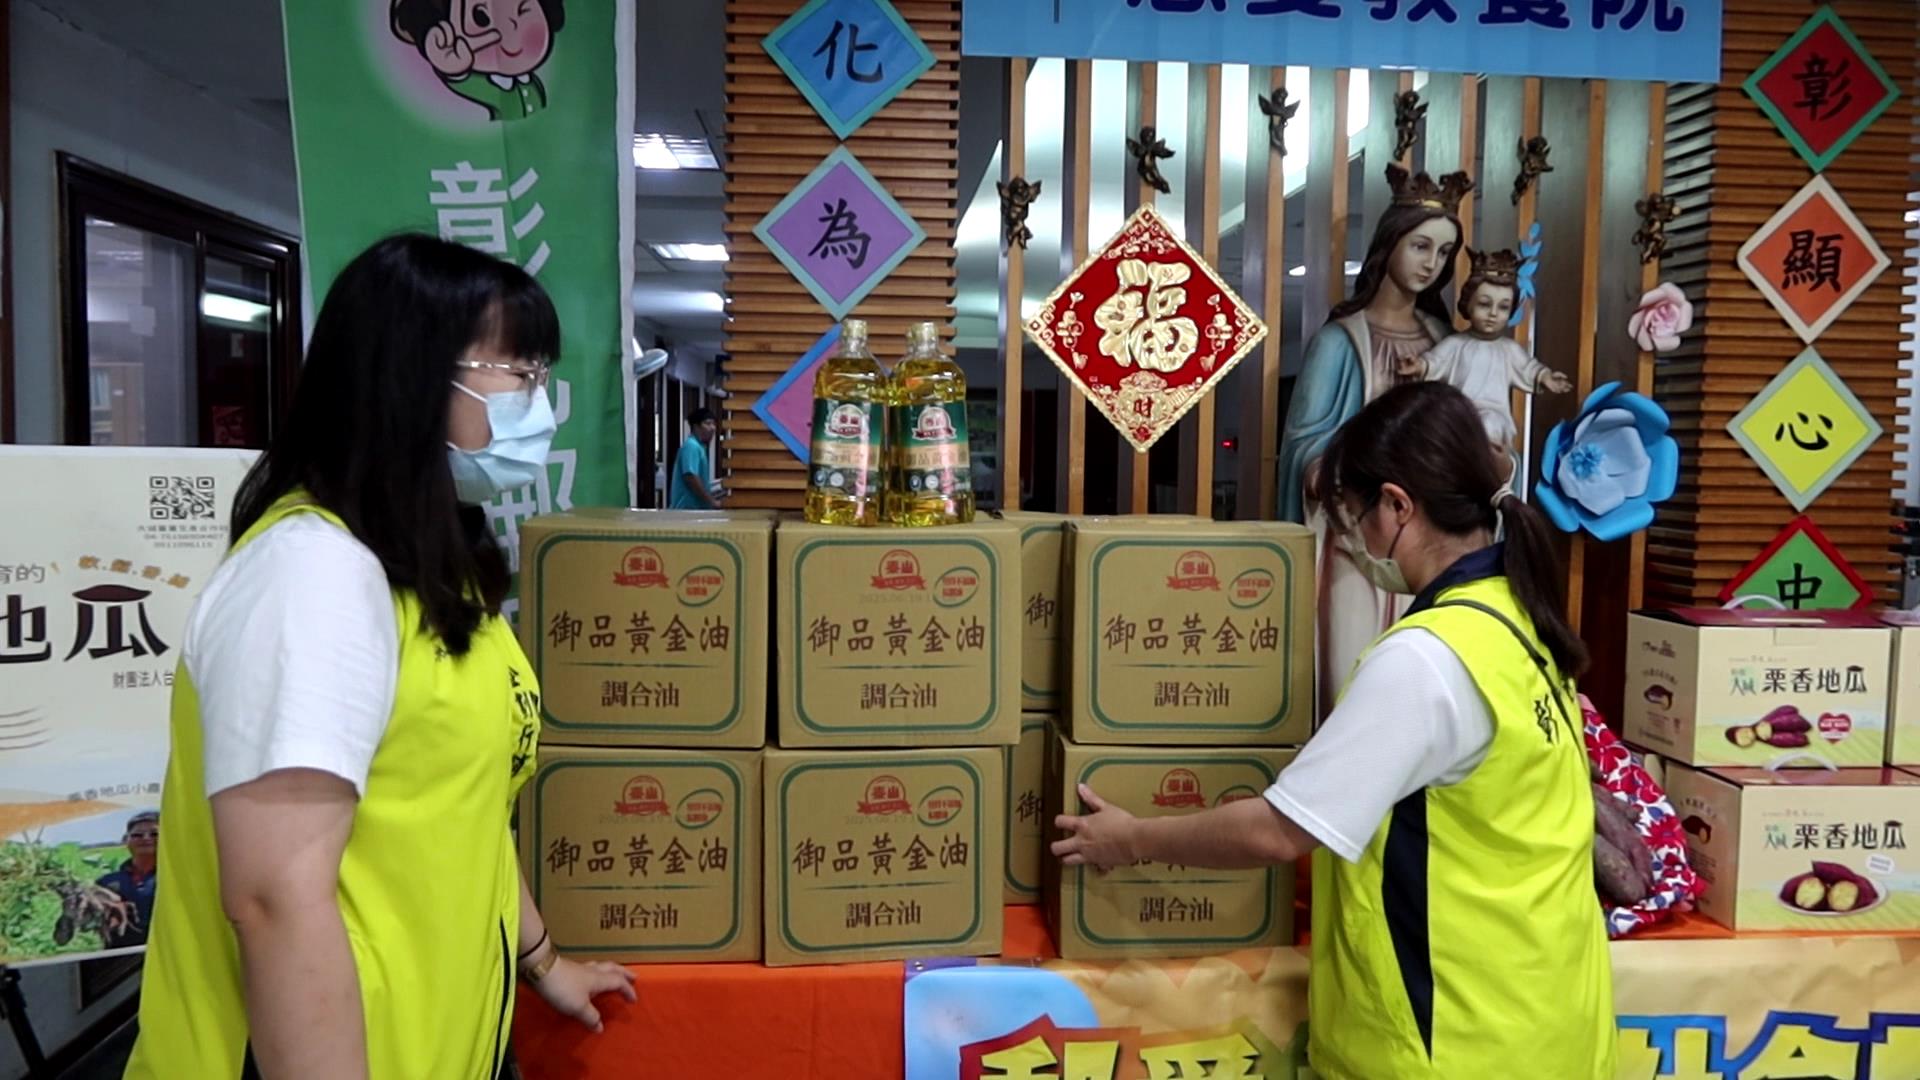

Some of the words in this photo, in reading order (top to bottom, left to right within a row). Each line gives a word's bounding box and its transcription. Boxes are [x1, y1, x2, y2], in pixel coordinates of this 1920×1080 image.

[813, 20, 884, 83] 化
[1791, 52, 1853, 121] 彰
[808, 199, 872, 270] 為
[1781, 229, 1845, 292] 顯
[1094, 259, 1199, 372] 福
[1775, 412, 1834, 451] 心
[1775, 562, 1823, 609] 中
[548, 610, 731, 654] 御品黃金油
[807, 612, 985, 656] 御品黃金油
[1104, 613, 1279, 656] 御品黃金油
[601, 681, 680, 708] 調合油
[860, 682, 937, 710] 調合油
[1154, 681, 1230, 708] 調合油
[1762, 665, 1867, 693] 栗香地瓜
[546, 834, 728, 878] 御品黃金油
[792, 832, 968, 876] 御品黃金油
[1792, 820, 1907, 850] 栗香地瓜
[600, 902, 678, 930] 調合油
[846, 900, 921, 929] 調合油
[1139, 896, 1214, 923] 調合油
